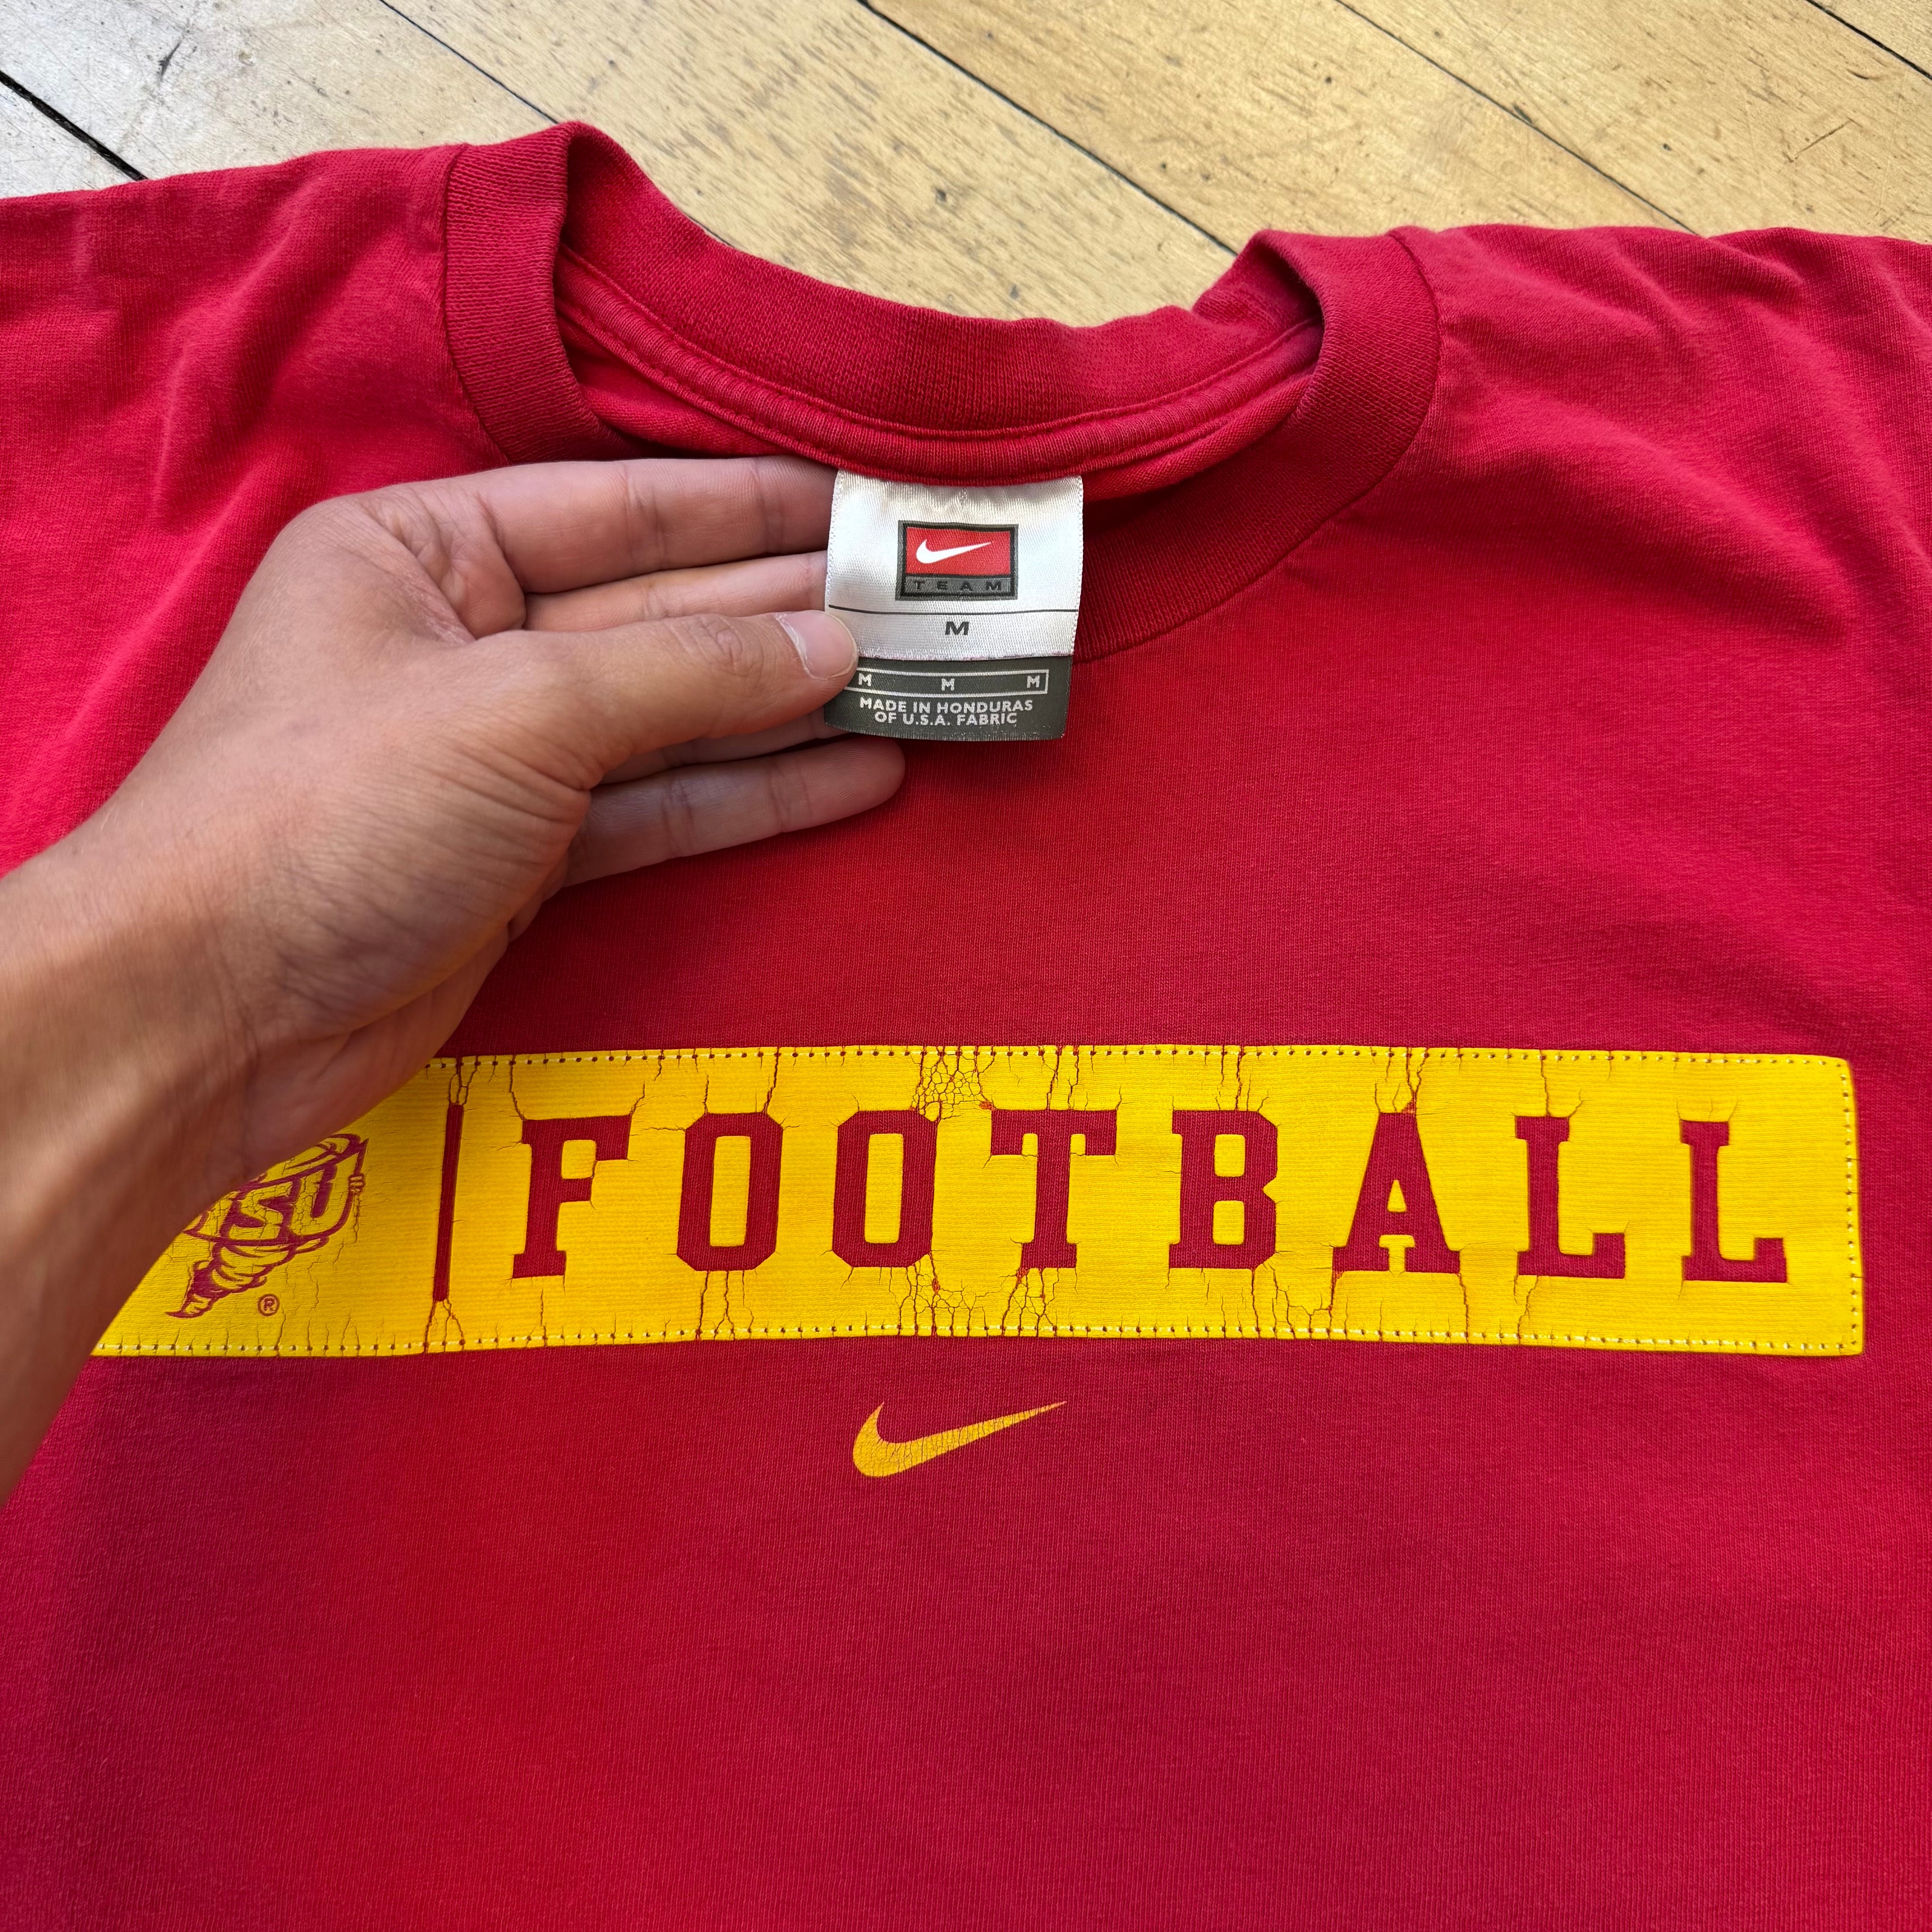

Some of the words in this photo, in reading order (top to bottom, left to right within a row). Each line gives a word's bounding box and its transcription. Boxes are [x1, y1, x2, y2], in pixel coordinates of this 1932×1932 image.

[914, 580, 1002, 591] TEAM
[944, 621, 970, 635] M
[858, 673, 872, 687] M
[941, 678, 955, 691] M
[1026, 675, 1040, 688] M
[859, 696, 907, 712] MADE
[913, 701, 931, 714] IN
[936, 700, 1033, 714] HONDURAS
[874, 711, 897, 723] OF
[902, 713, 950, 726] U.S.A.
[956, 712, 1017, 726] FABRIC
[512, 1108, 1788, 1283] FOOTBALL
